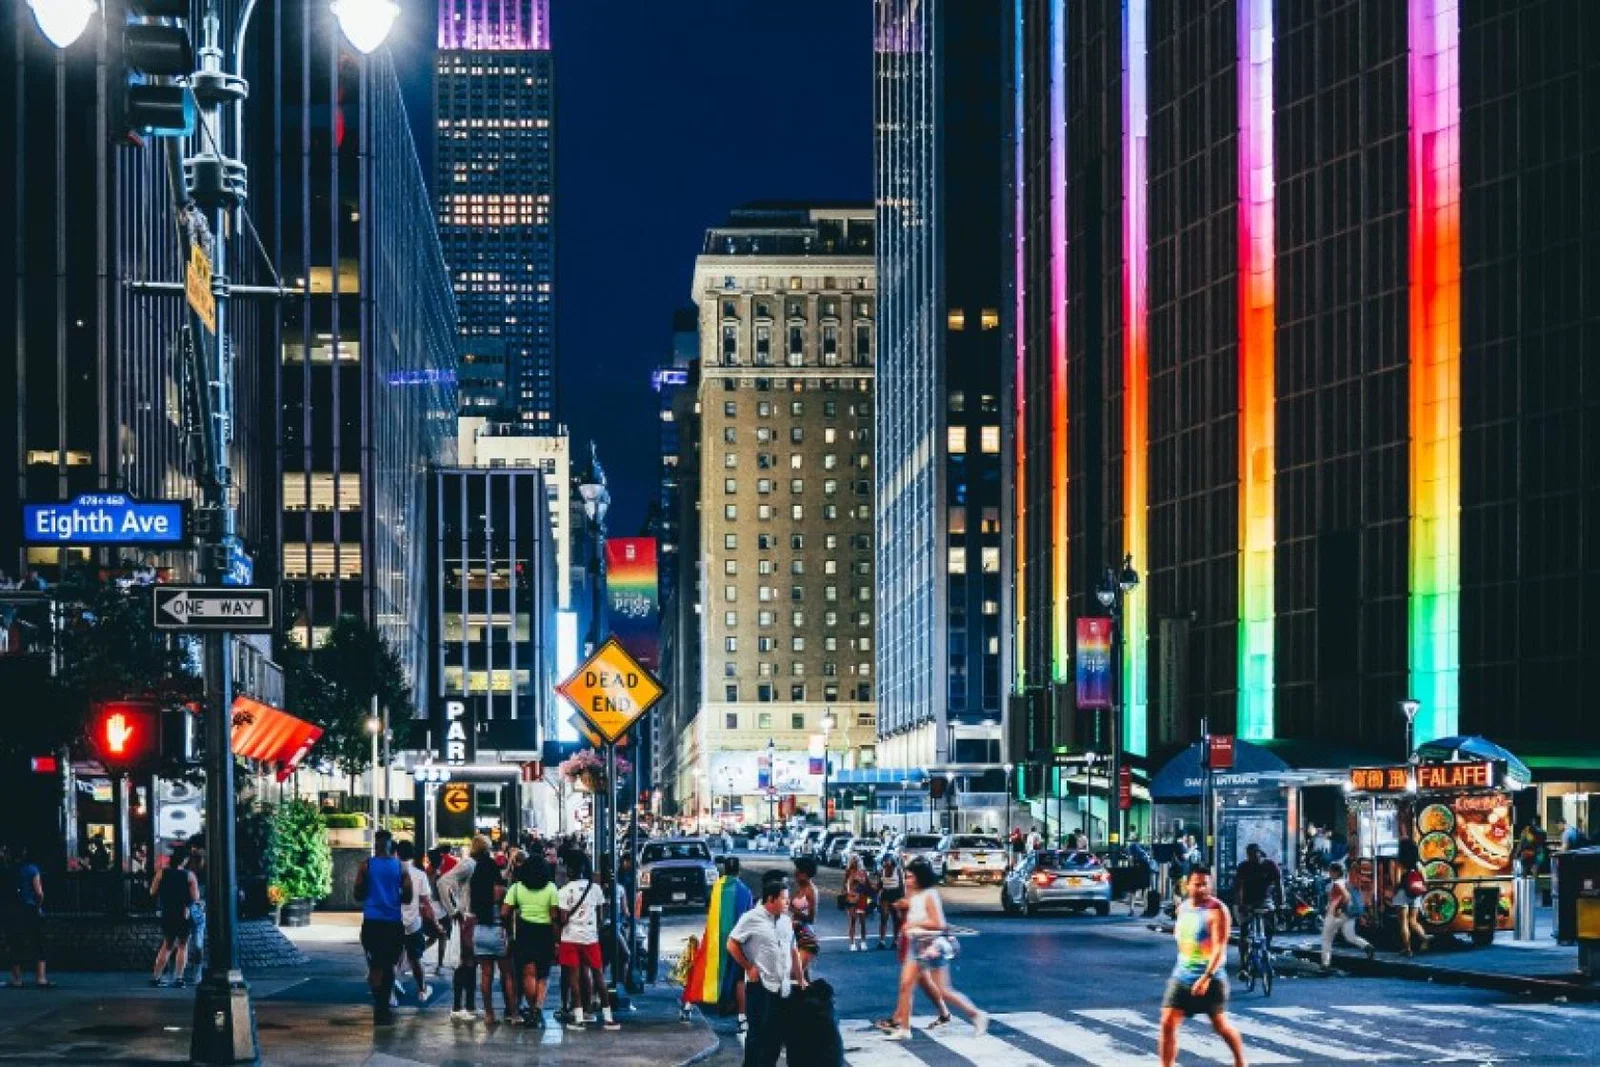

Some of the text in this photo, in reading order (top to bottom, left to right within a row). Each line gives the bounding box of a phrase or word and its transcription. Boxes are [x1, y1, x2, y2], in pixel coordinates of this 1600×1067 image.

[36, 509, 169, 539] Eighth Ave
[173, 600, 254, 615] ONE WAY
[586, 671, 639, 689] DEAD
[592, 695, 631, 712] END
